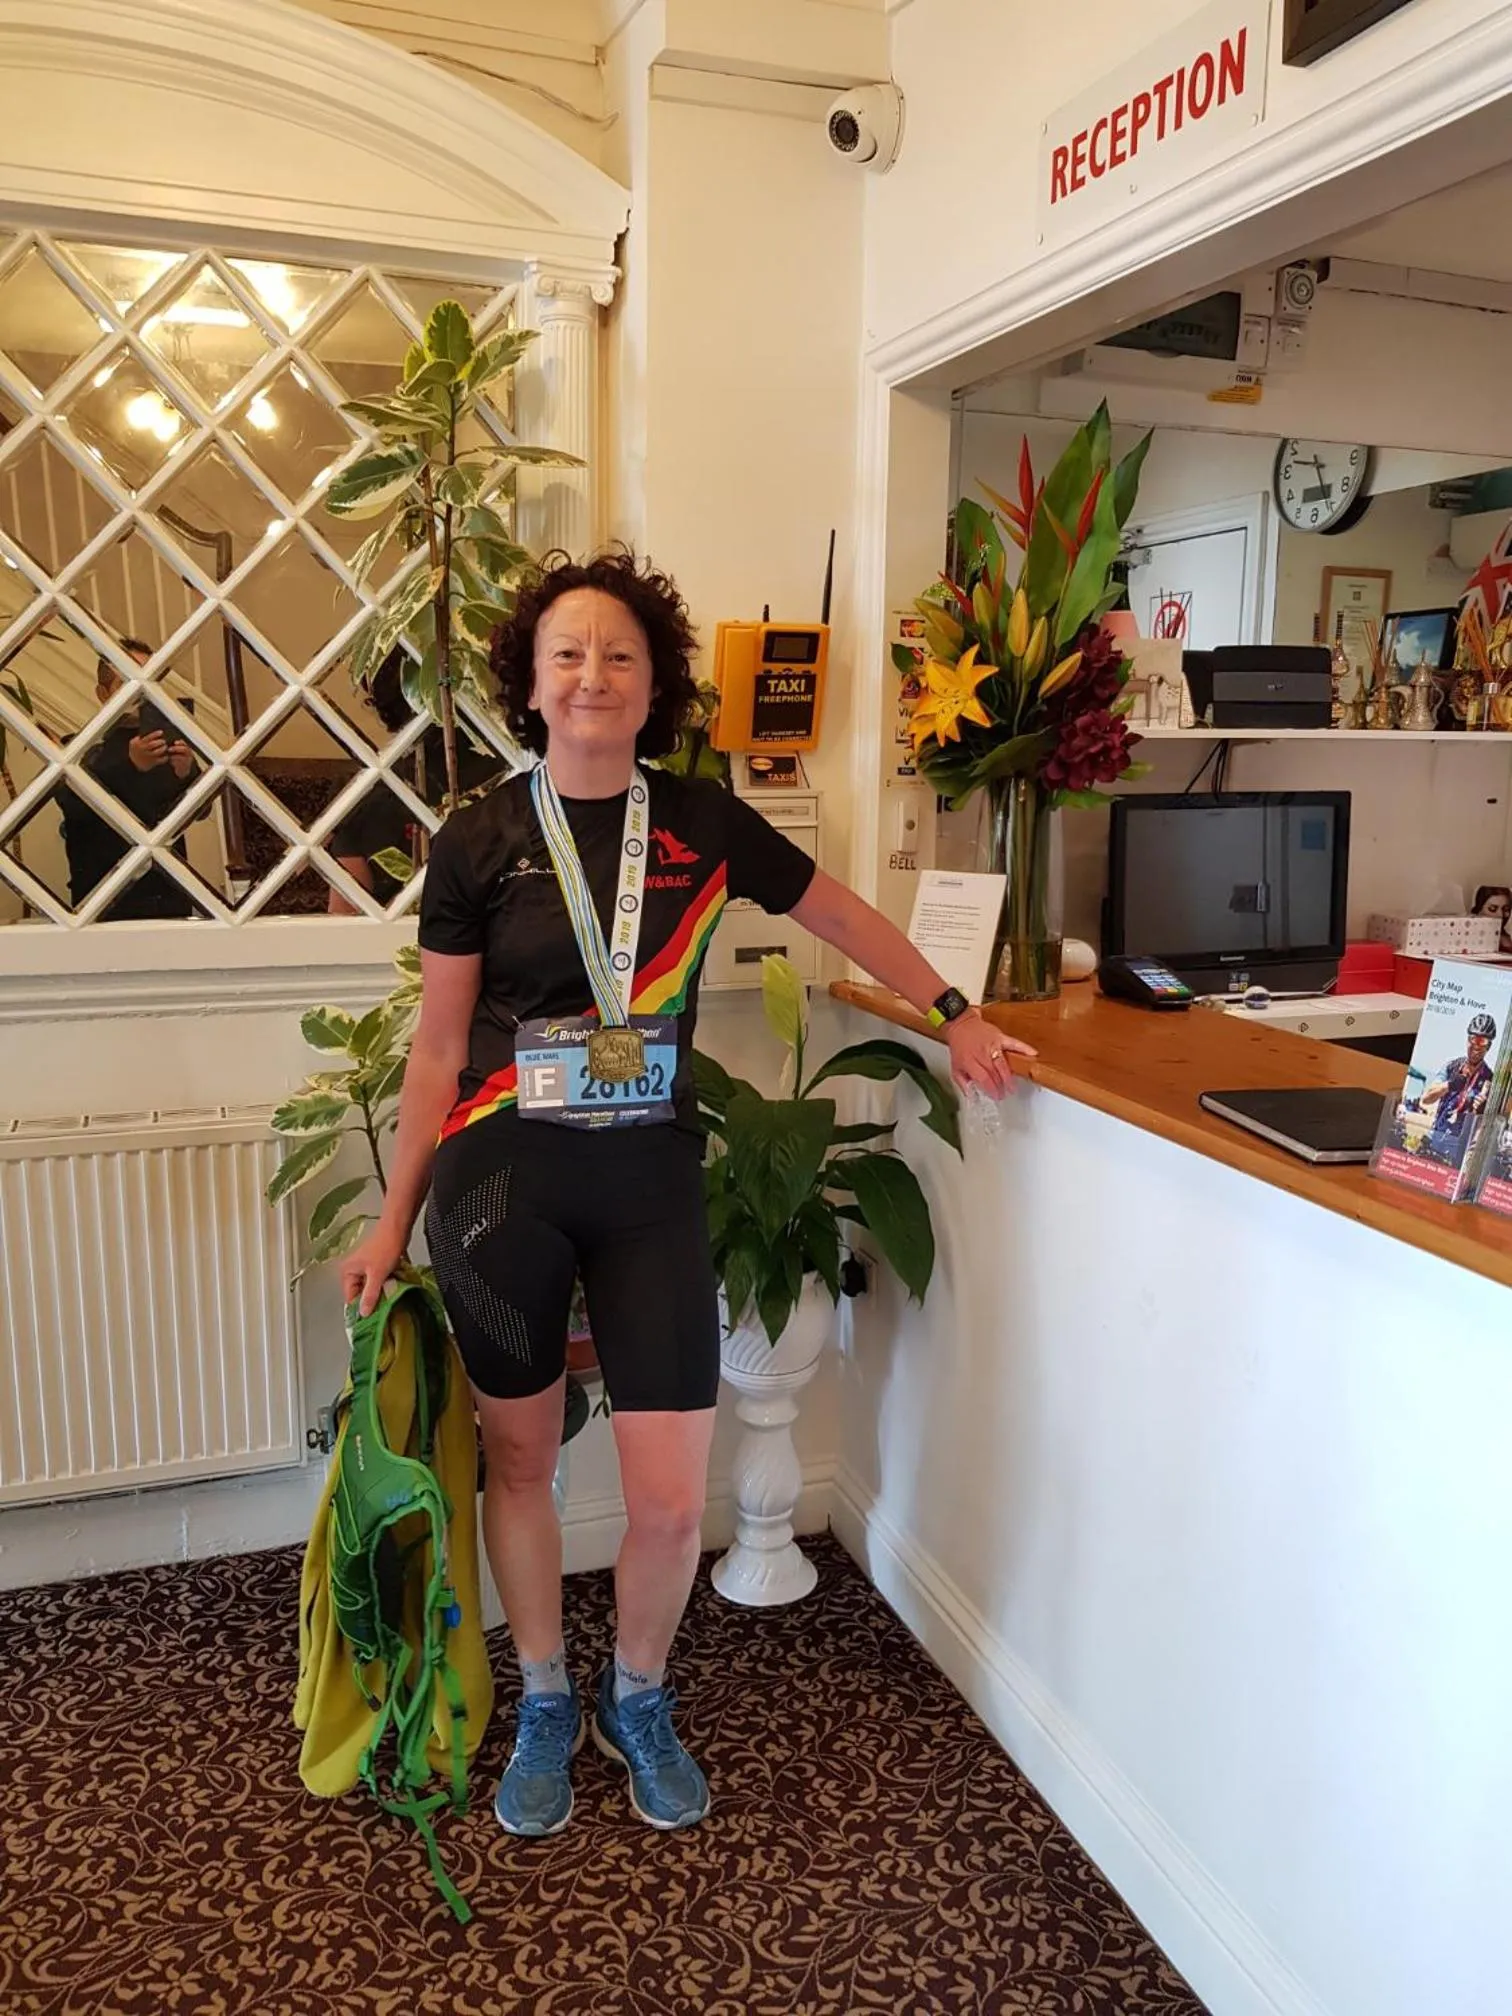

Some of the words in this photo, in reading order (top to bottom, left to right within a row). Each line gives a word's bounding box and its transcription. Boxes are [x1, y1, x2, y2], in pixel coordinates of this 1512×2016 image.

[1050, 26, 1247, 204] RECEPTION
[767, 679, 806, 694] TAXI
[758, 694, 813, 704] FREEPHONE
[767, 773, 796, 782] TAXIS
[889, 854, 917, 870] BELL
[626, 864, 637, 888] 2019
[620, 921, 631, 944] 2019
[1446, 982, 1463, 993] Map
[534, 1067, 556, 1098] F
[461, 1217, 487, 1249] 2XU
